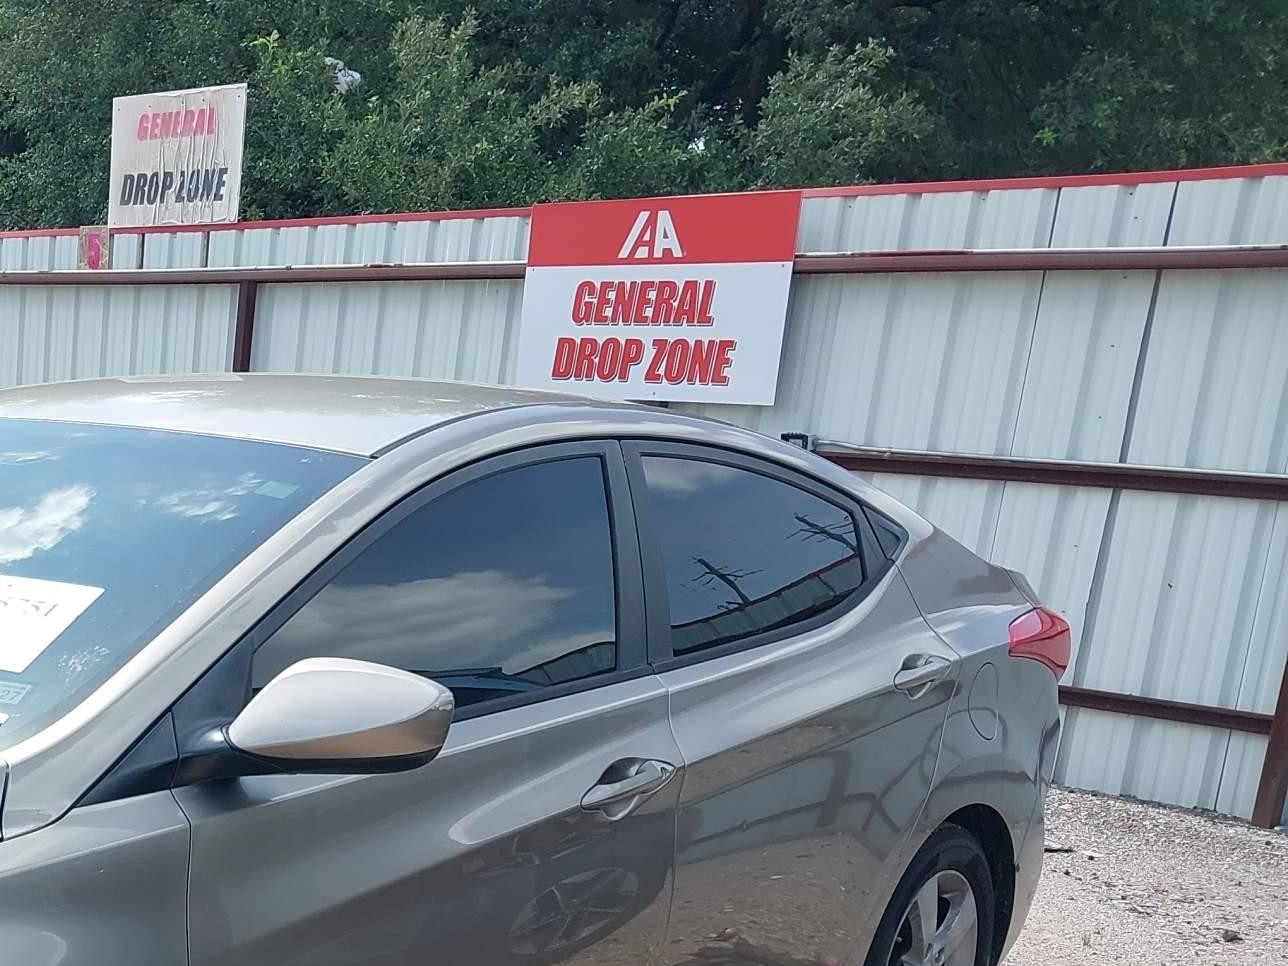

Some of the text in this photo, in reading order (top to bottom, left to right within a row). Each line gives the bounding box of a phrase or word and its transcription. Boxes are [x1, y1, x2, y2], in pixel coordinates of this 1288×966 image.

[136, 107, 216, 142] GENERAL
[119, 167, 229, 206] DROP ZONE
[571, 279, 717, 327] GENERAL
[551, 337, 737, 386] DROP ZONE
